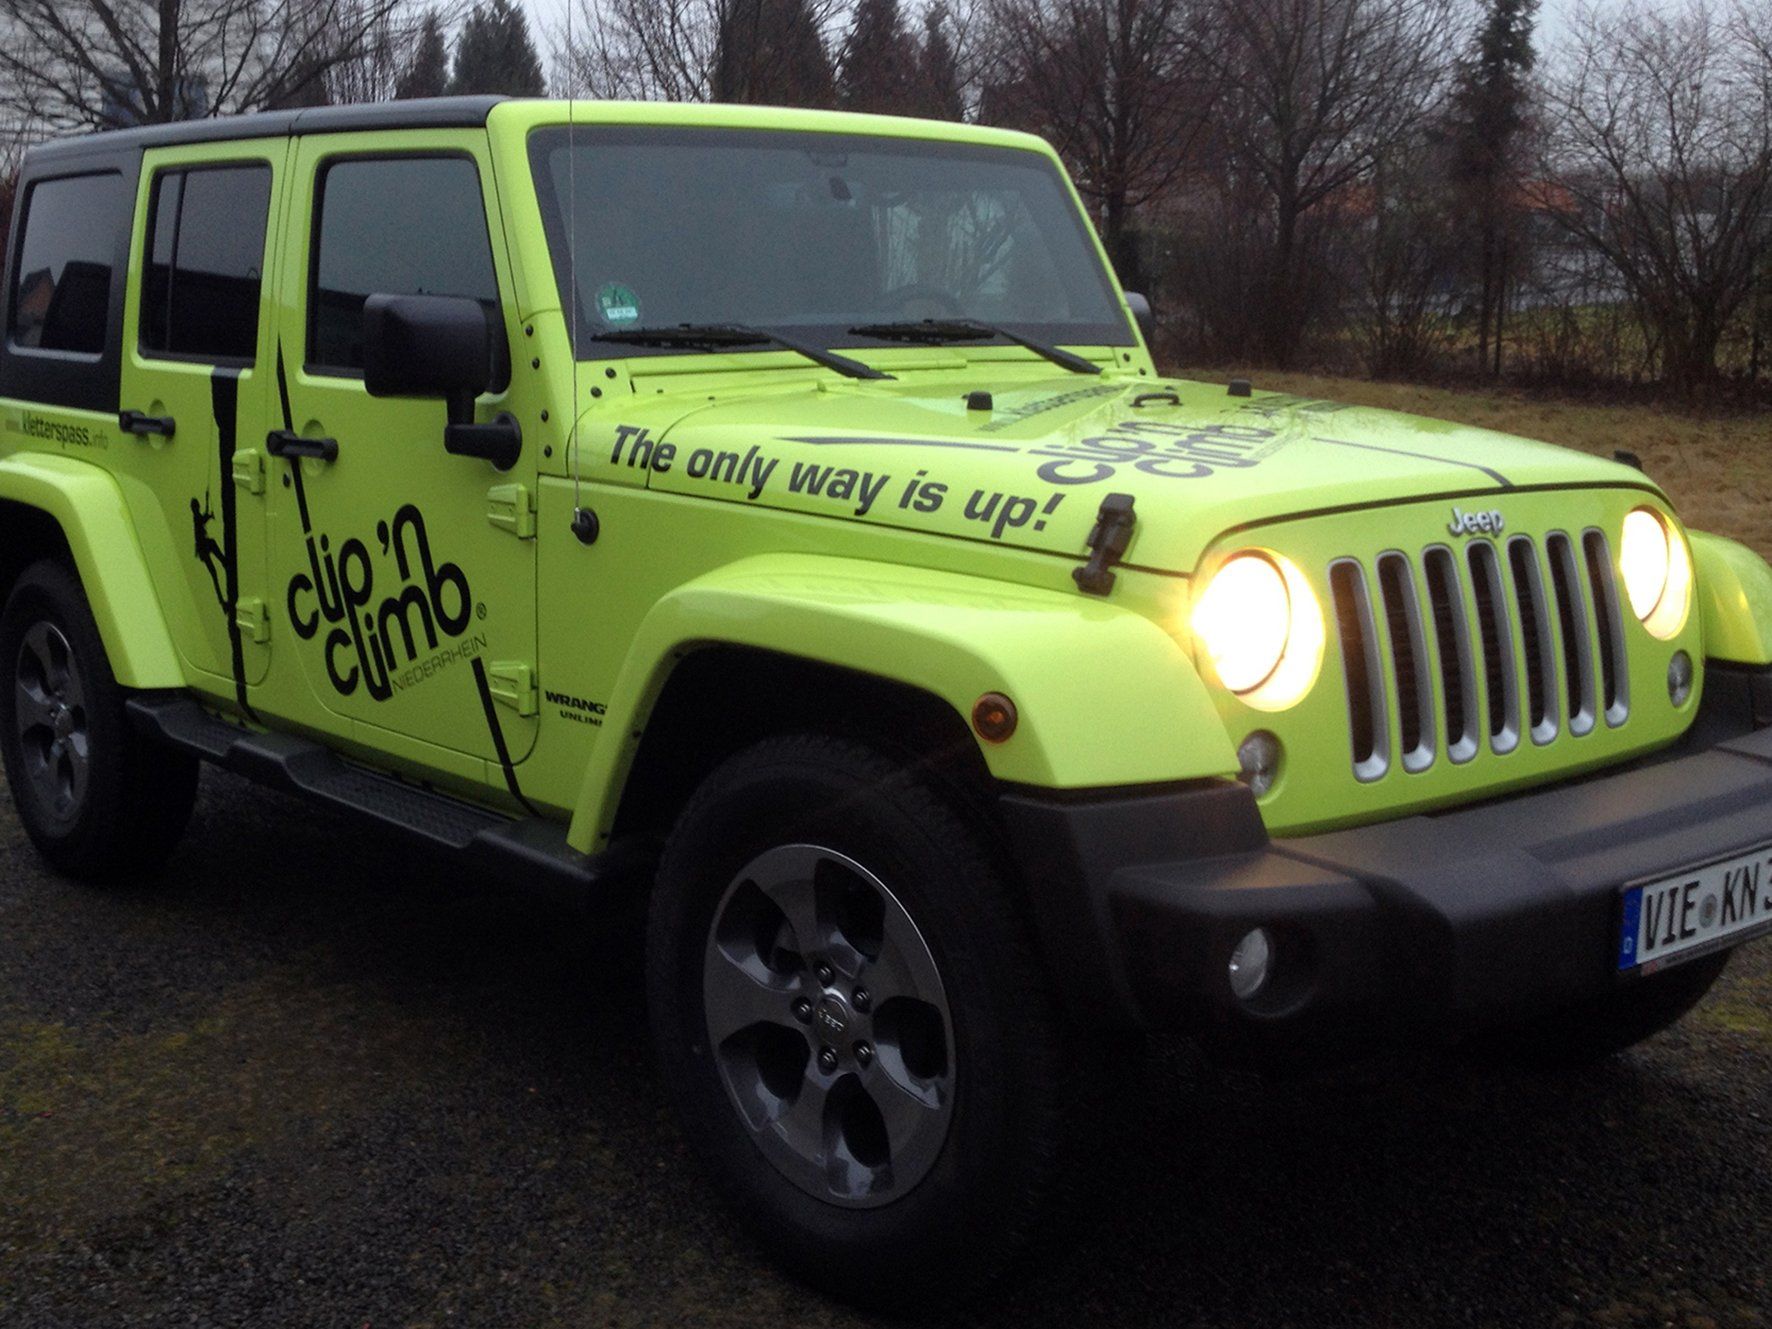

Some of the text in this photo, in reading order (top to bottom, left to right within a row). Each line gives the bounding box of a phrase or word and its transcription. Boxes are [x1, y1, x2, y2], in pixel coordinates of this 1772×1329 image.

[610, 425, 1067, 539] The only way is up!
[1448, 506, 1504, 538] Jeep
[392, 632, 488, 692] NIEDERRHEIN
[1645, 880, 1700, 951] VIE
